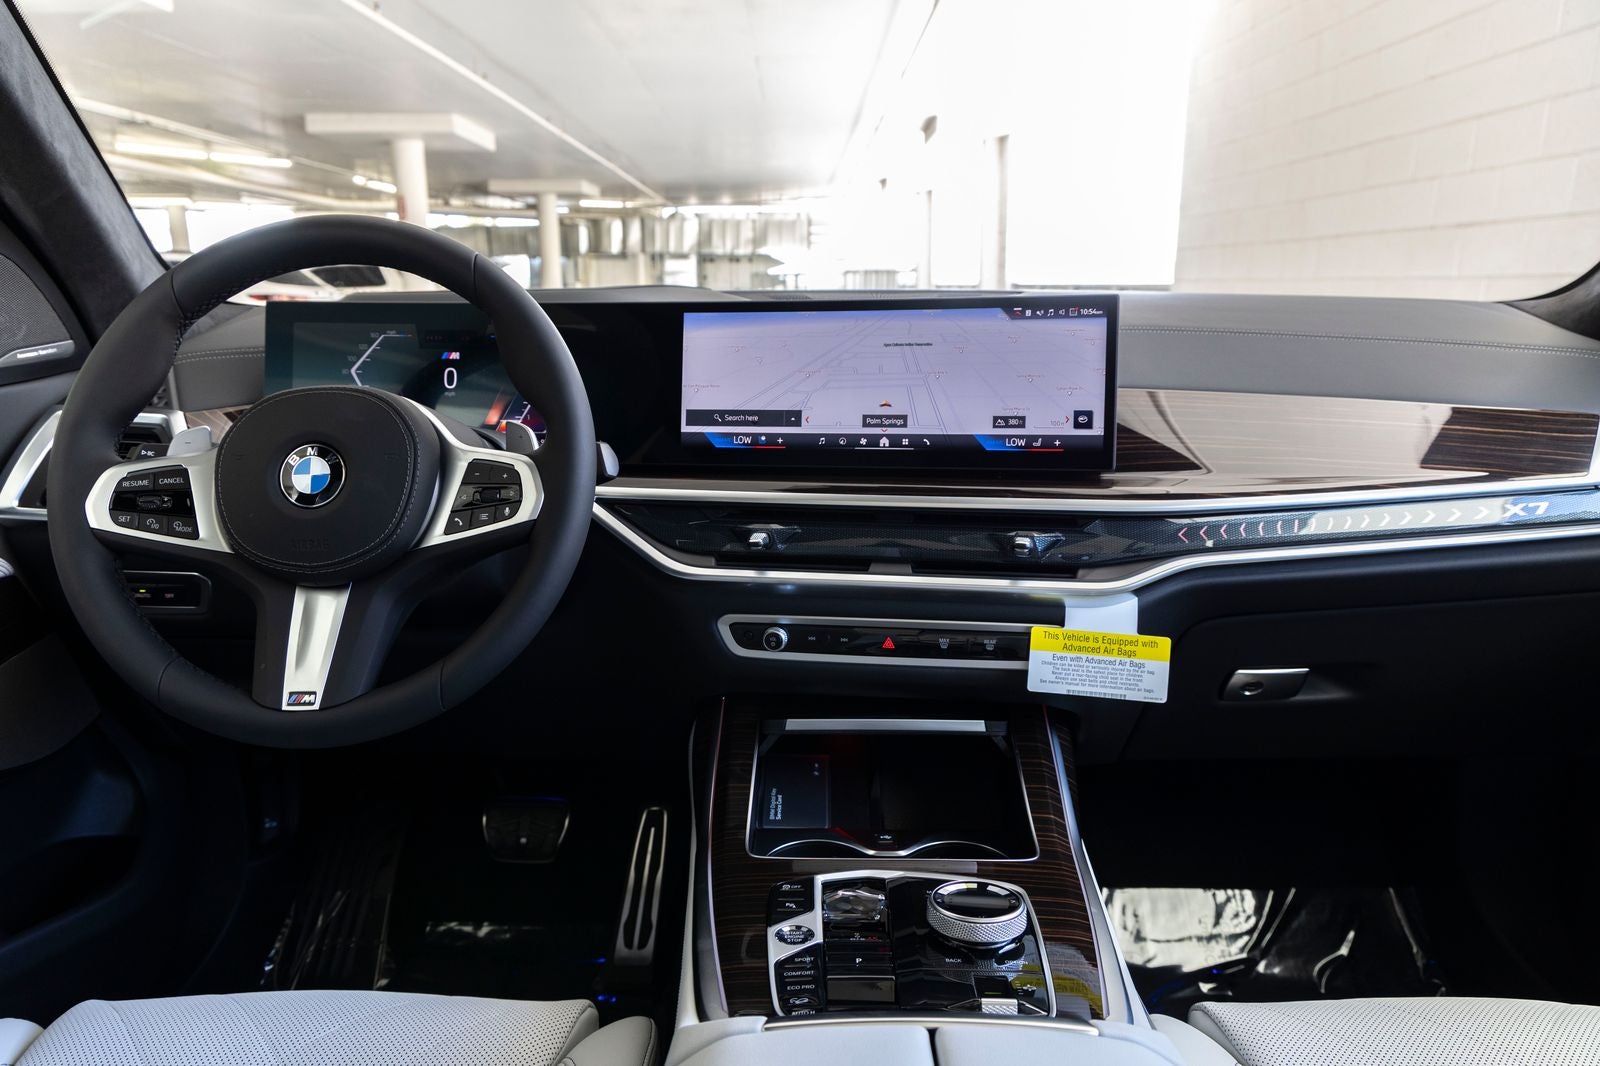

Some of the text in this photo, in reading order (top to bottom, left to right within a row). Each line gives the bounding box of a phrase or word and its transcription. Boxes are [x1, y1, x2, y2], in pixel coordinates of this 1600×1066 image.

[444, 367, 457, 389] 0
[883, 418, 904, 426] Springs
[1006, 438, 1026, 446] LOW
[288, 447, 339, 466] BMW
[1503, 501, 1550, 518] X7
[1044, 631, 1159, 648] This Vehicle is Equipped with
[1062, 643, 1136, 658] Advanced Air Bags
[1085, 657, 1116, 666] Advanced
[1129, 660, 1145, 669] Bags
